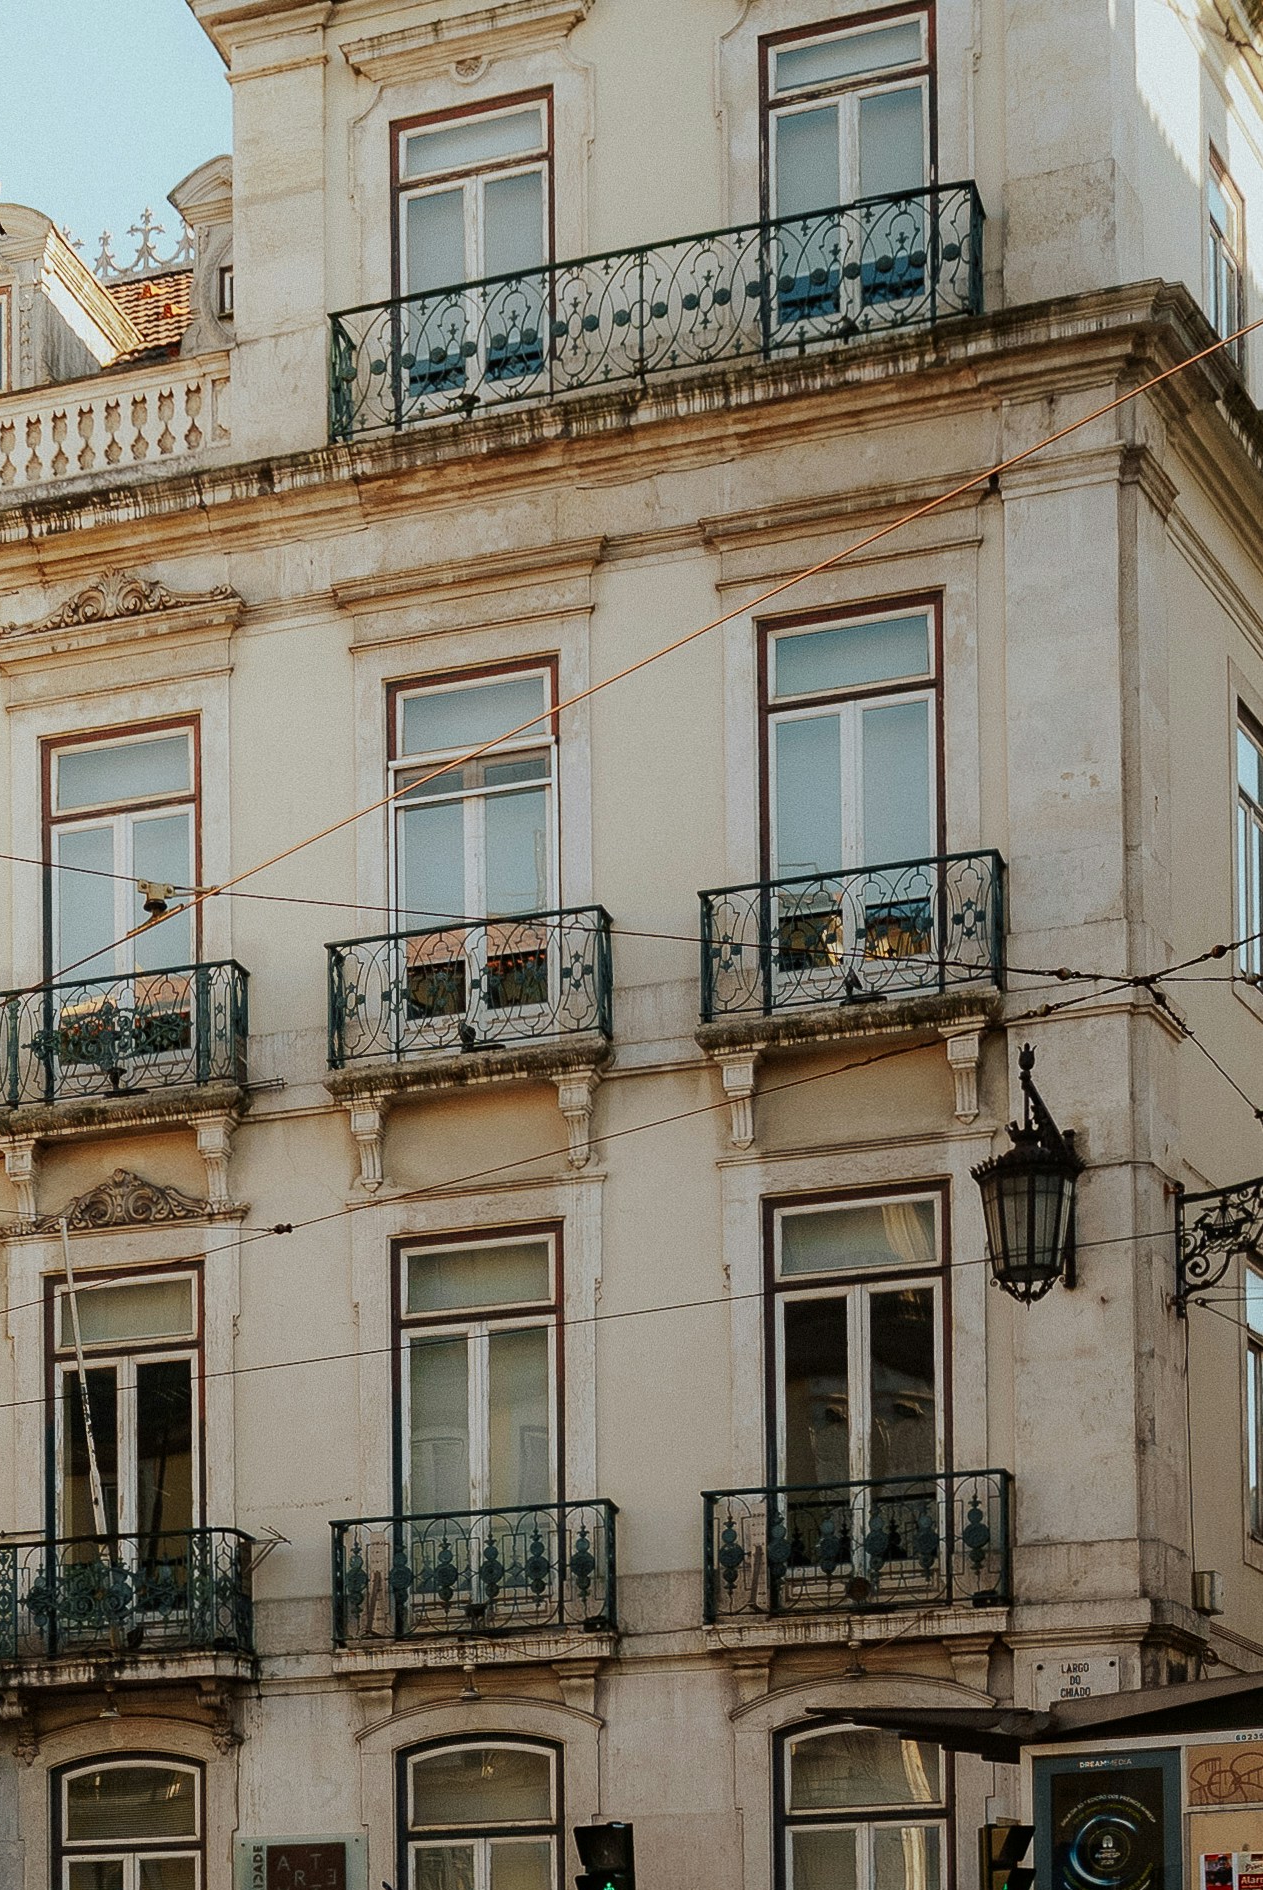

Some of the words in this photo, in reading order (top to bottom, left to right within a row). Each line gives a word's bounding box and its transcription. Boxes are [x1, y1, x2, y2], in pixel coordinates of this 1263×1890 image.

[1061, 1663, 1090, 1674] LARGO
[1069, 1675, 1081, 1685] DO
[1060, 1687, 1091, 1698] CHIADO
